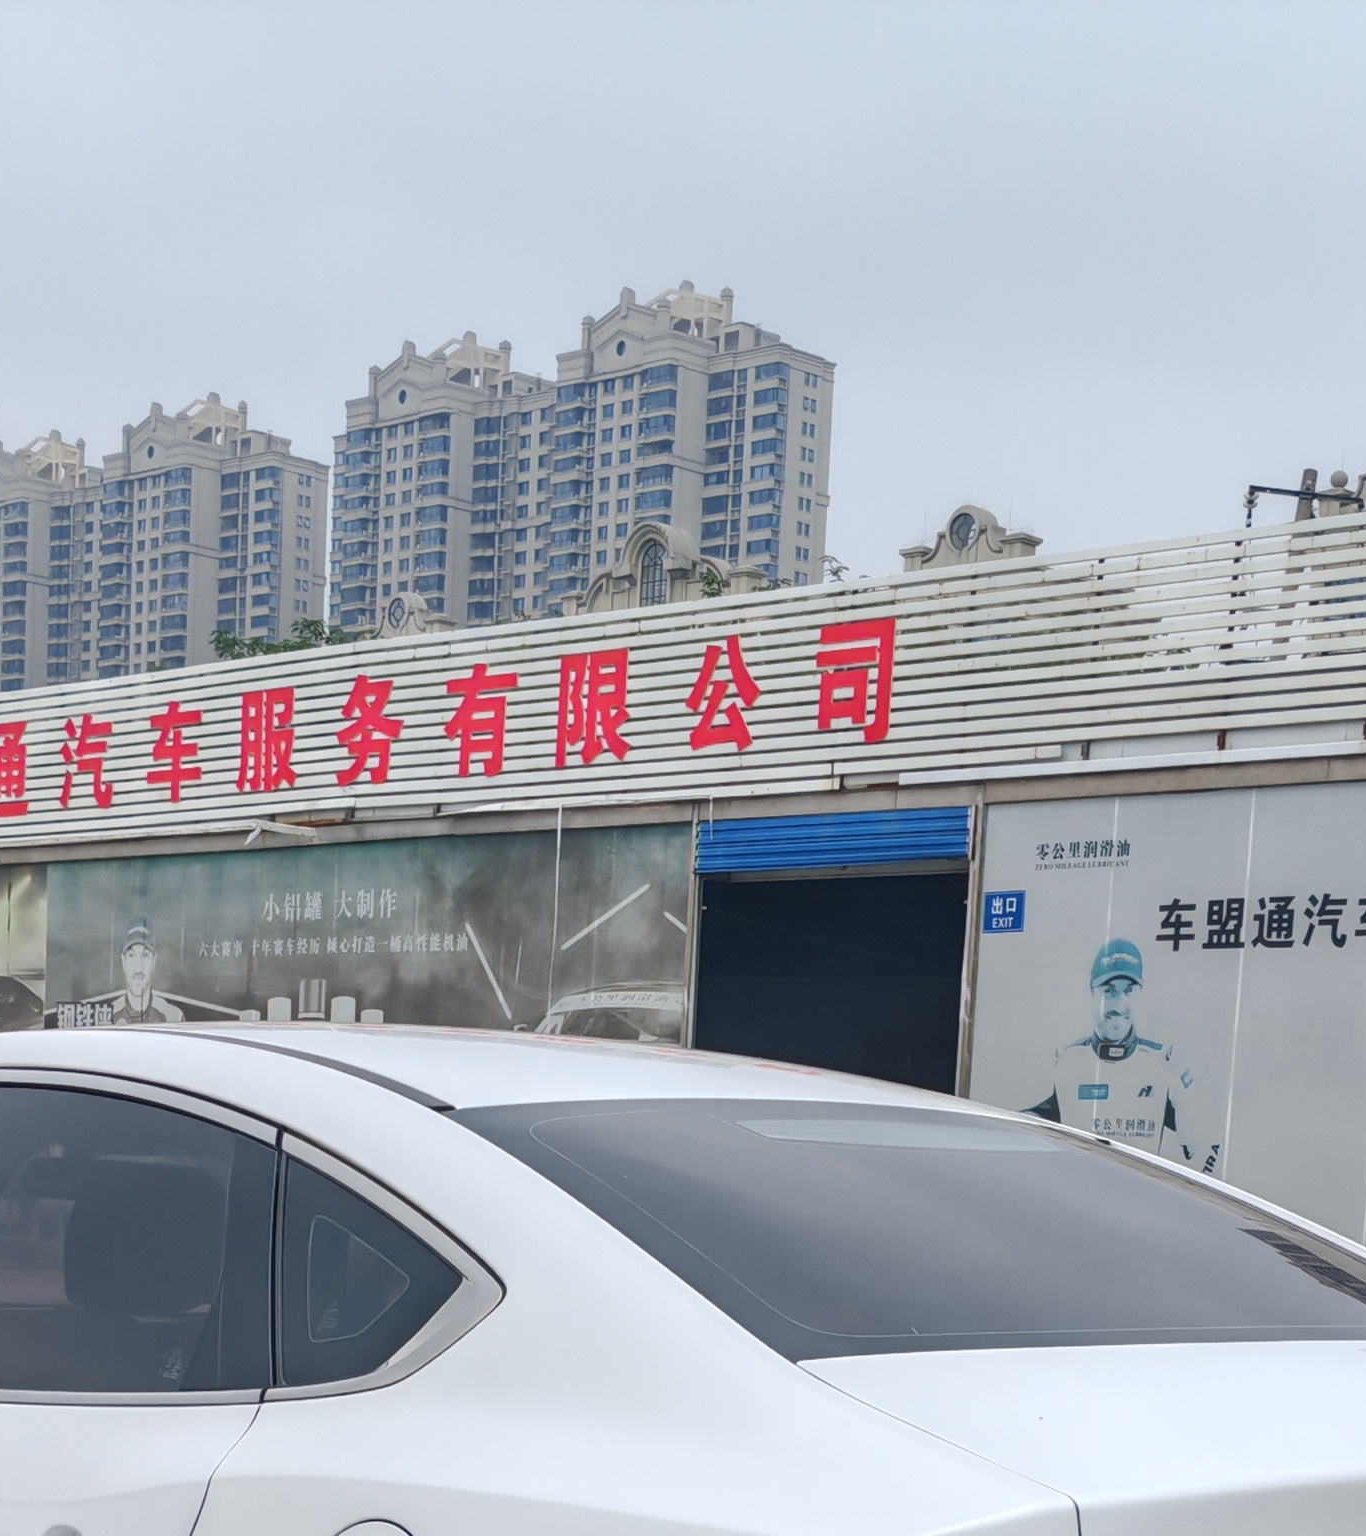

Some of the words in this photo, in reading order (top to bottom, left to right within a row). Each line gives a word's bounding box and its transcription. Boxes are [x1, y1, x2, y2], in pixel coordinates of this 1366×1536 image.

[1036, 839, 1131, 860] 零公里润滑油
[1035, 863, 1054, 871] ZERO
[1055, 861, 1087, 870] MILEAGE
[262, 891, 323, 923] 小铝罐
[335, 888, 398, 919] 大制作
[991, 896, 1017, 915] 出口
[992, 916, 1014, 929] EXIT
